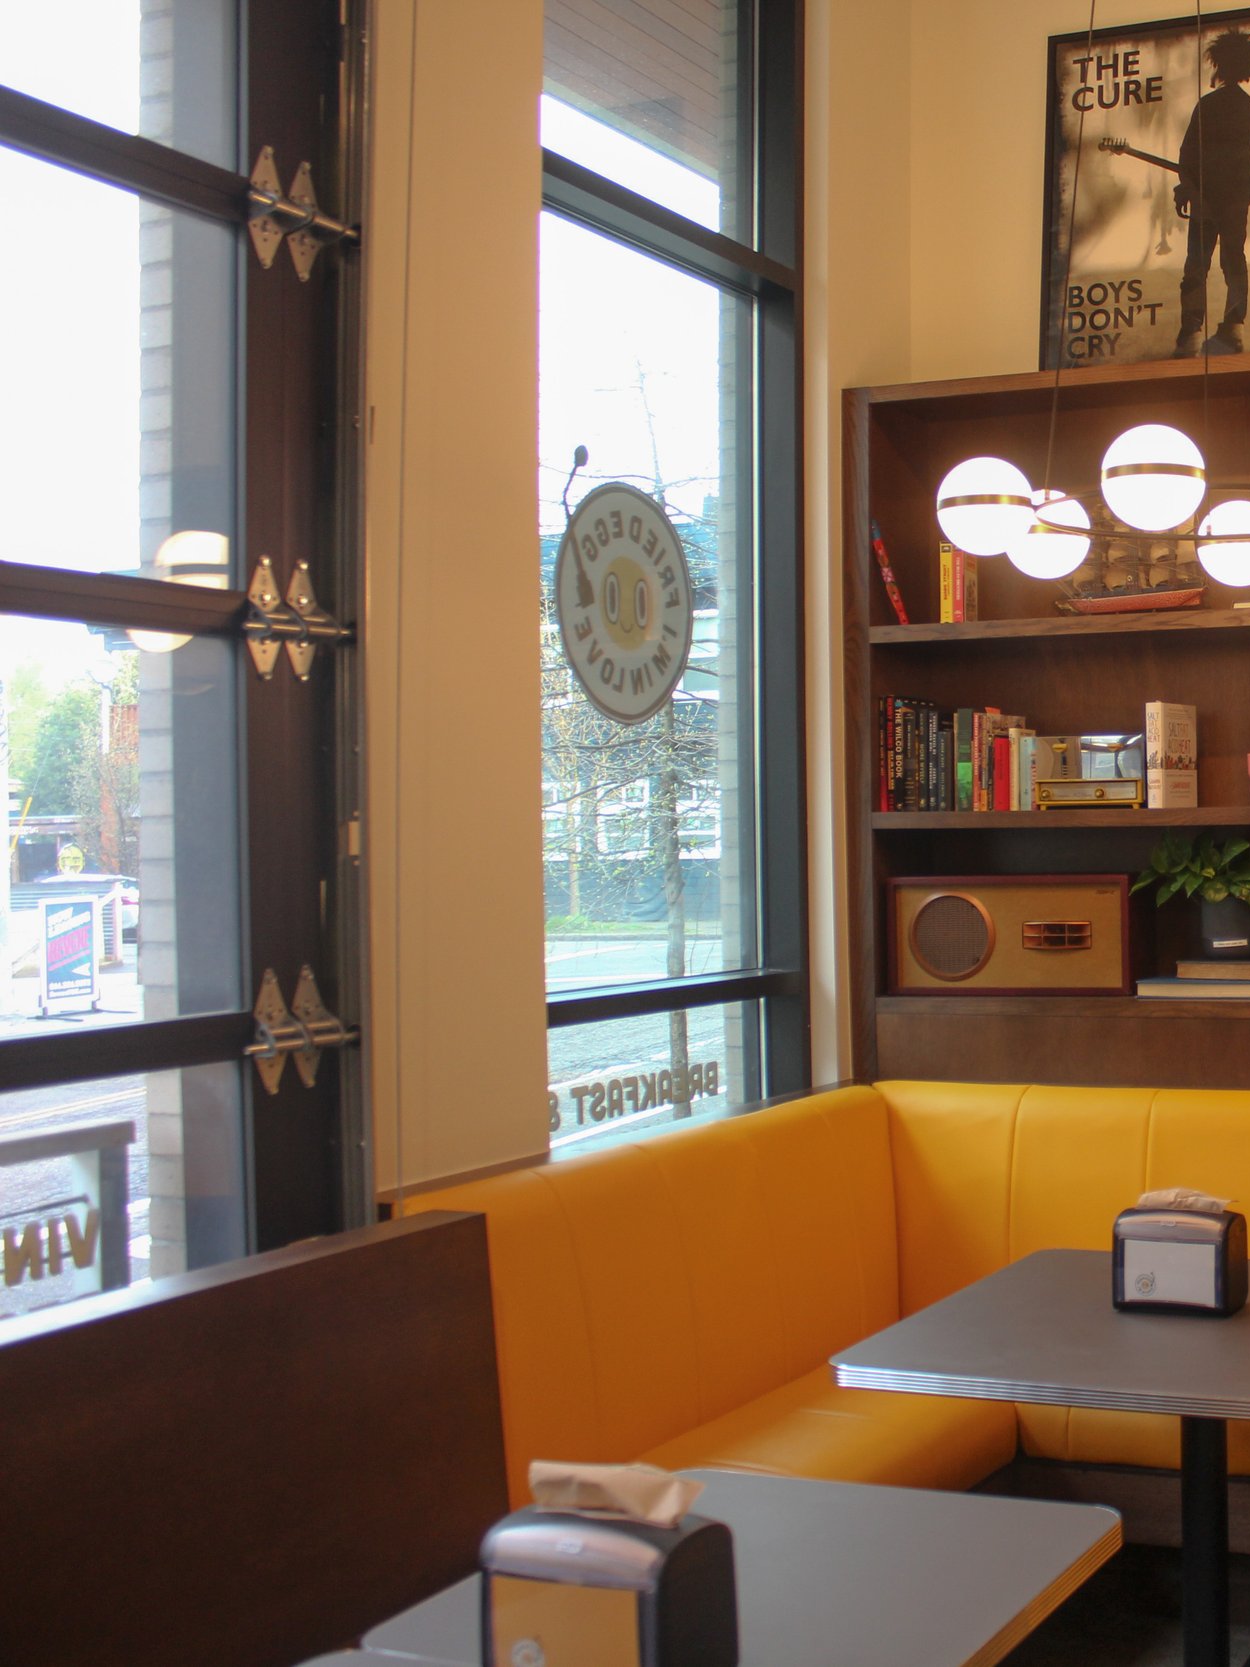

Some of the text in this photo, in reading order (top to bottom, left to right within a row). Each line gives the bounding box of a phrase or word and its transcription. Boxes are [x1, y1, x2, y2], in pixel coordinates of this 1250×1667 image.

[1073, 51, 1140, 83] THE
[1071, 76, 1163, 112] CURE
[1067, 280, 1143, 309] BOYS
[1067, 303, 1163, 334] DON'T
[1067, 333, 1122, 360] CRY
[895, 726, 903, 753] WILCO
[895, 755, 903, 779] BOOK
